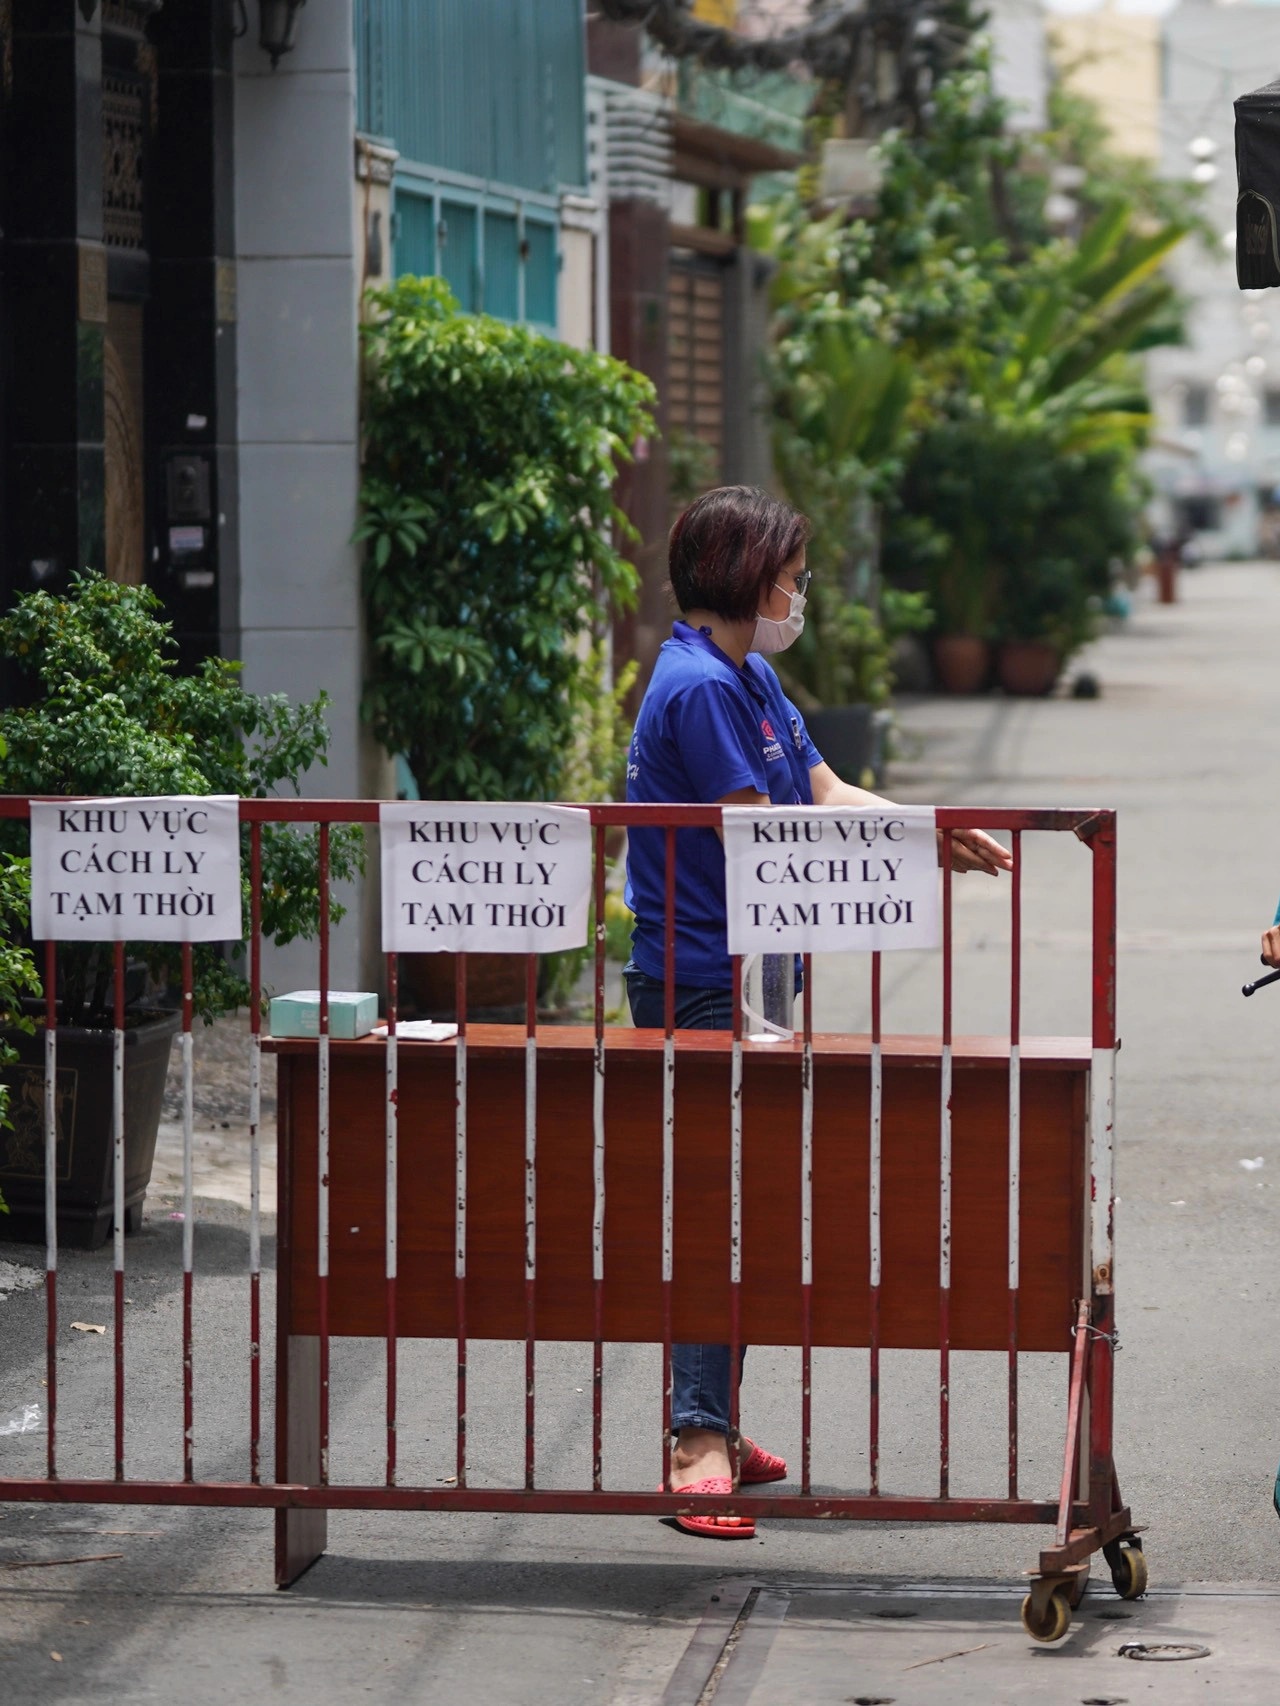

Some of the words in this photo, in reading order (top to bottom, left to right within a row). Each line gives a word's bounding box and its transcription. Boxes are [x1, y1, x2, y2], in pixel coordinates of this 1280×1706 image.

[58, 810, 128, 834] KHU
[138, 807, 208, 840] VỰC
[408, 821, 479, 844] KHU
[489, 819, 560, 851] VỰC
[753, 821, 823, 843] KHU
[834, 816, 905, 848] VỰC
[60, 843, 151, 874] CÁCH
[164, 851, 206, 874] LY
[411, 858, 503, 884] CÁCH
[515, 862, 557, 885] LY
[756, 854, 848, 884] CÁCH
[862, 859, 903, 882] LY
[50, 892, 125, 922] TẠM
[133, 886, 216, 916] THỜI
[402, 902, 474, 932] TẠM
[485, 897, 567, 927] THỜI
[746, 903, 820, 933] TẠM
[831, 894, 915, 925] THỜI
